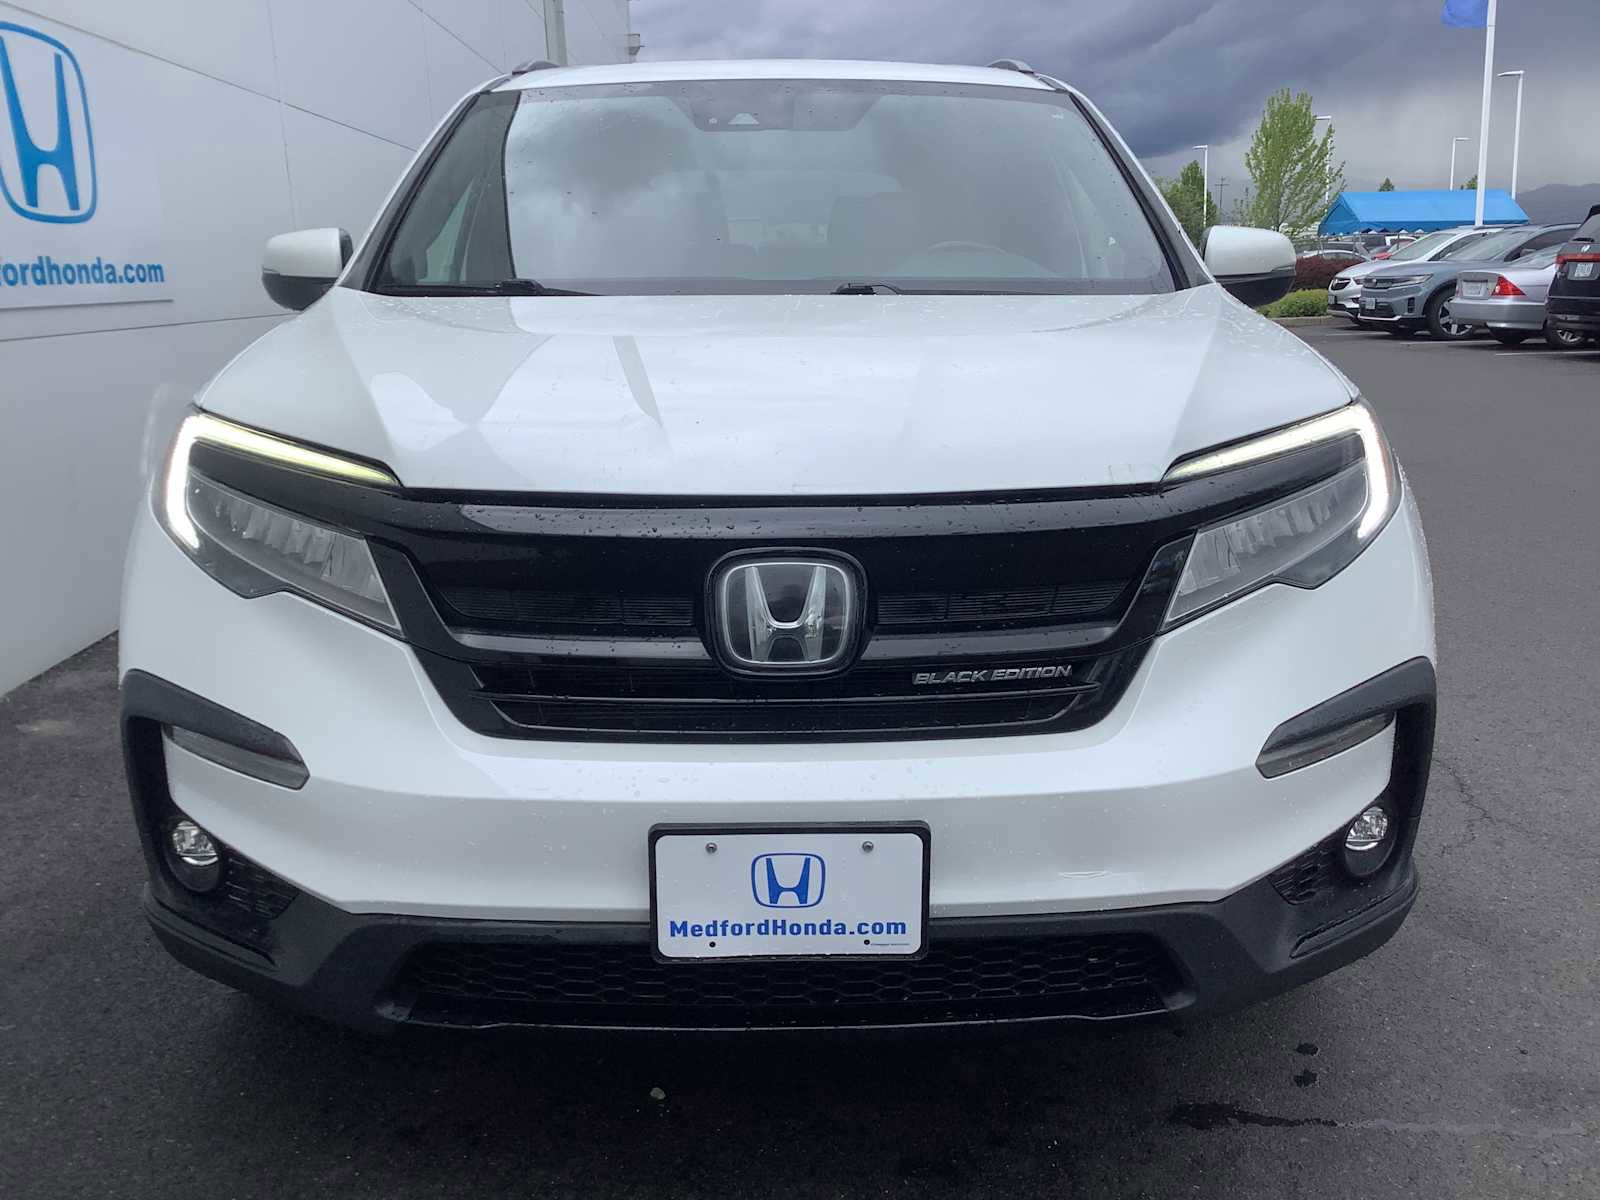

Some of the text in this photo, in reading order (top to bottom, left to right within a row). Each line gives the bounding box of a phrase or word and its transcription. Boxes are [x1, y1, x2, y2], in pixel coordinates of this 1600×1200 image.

[0, 255, 165, 287] ordhonda.com
[913, 665, 1072, 685] BLACK EDITION
[669, 919, 907, 937] MedfordHonda.com
